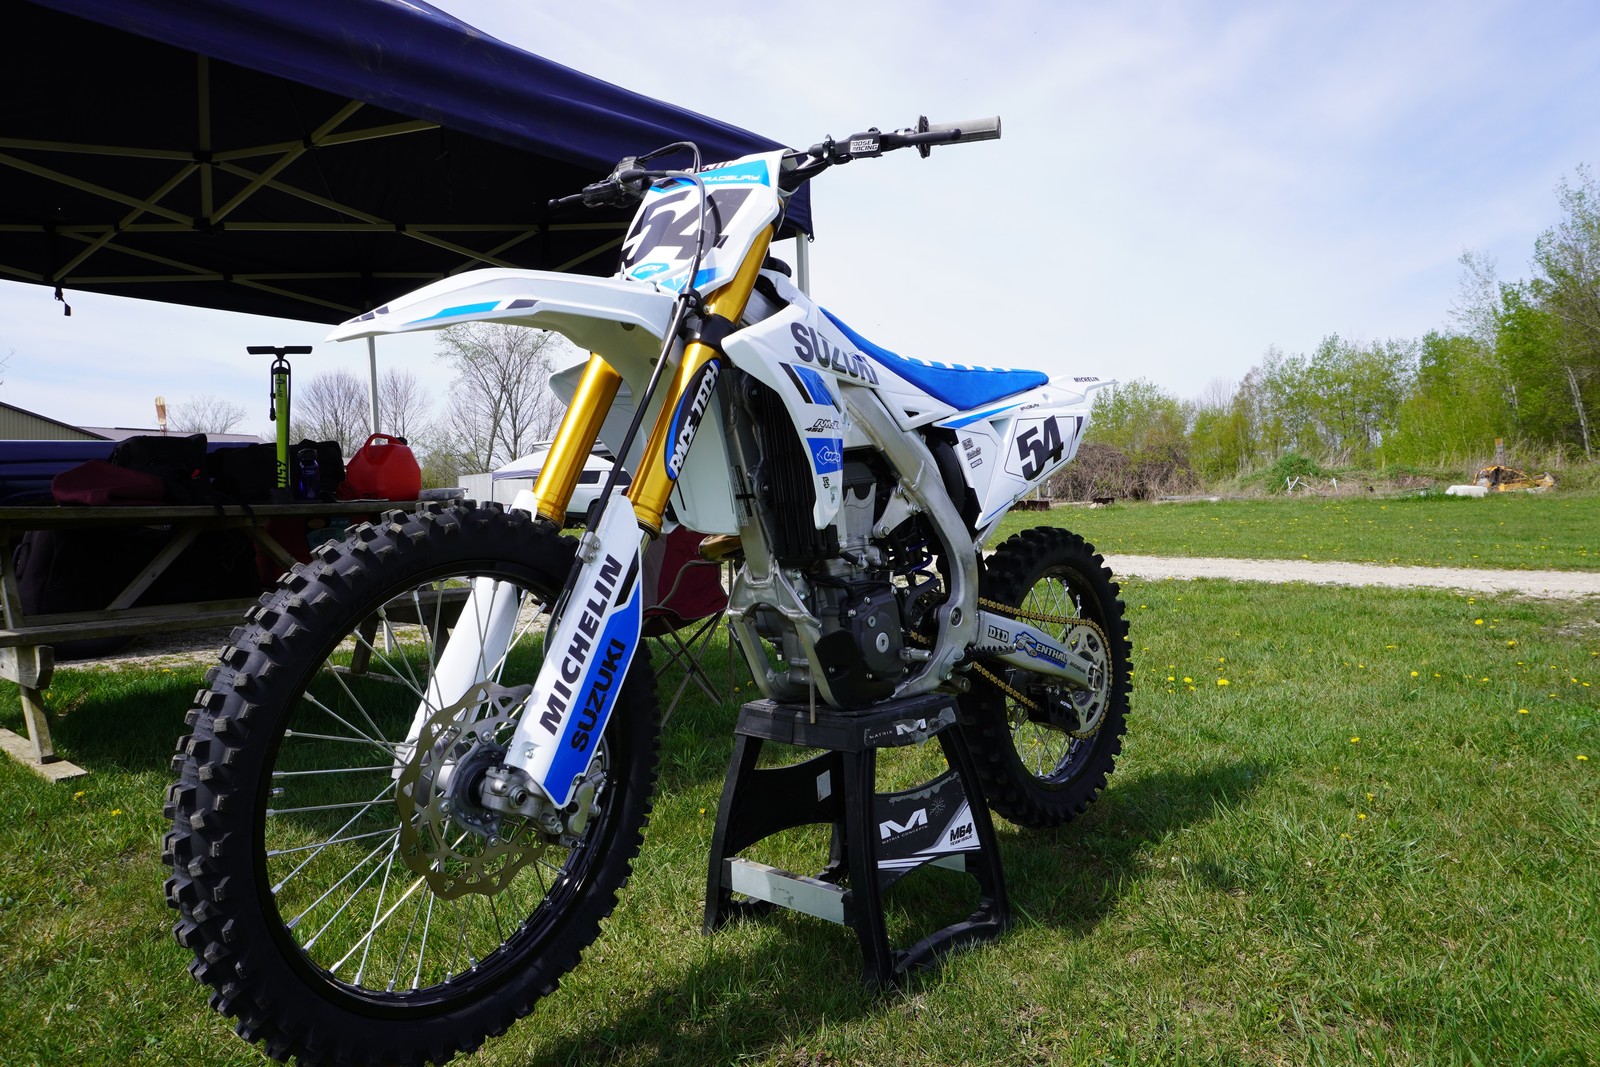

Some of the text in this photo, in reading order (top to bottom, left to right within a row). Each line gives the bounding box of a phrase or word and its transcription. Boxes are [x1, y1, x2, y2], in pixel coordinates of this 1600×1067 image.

[621, 188, 752, 269] 54
[790, 322, 880, 385] SUZUKI
[669, 360, 720, 478] RACE TECH
[1016, 414, 1064, 481] 54
[539, 553, 623, 736] MICHELIN
[570, 637, 626, 753] SUZUKI
[950, 822, 972, 842] M64
